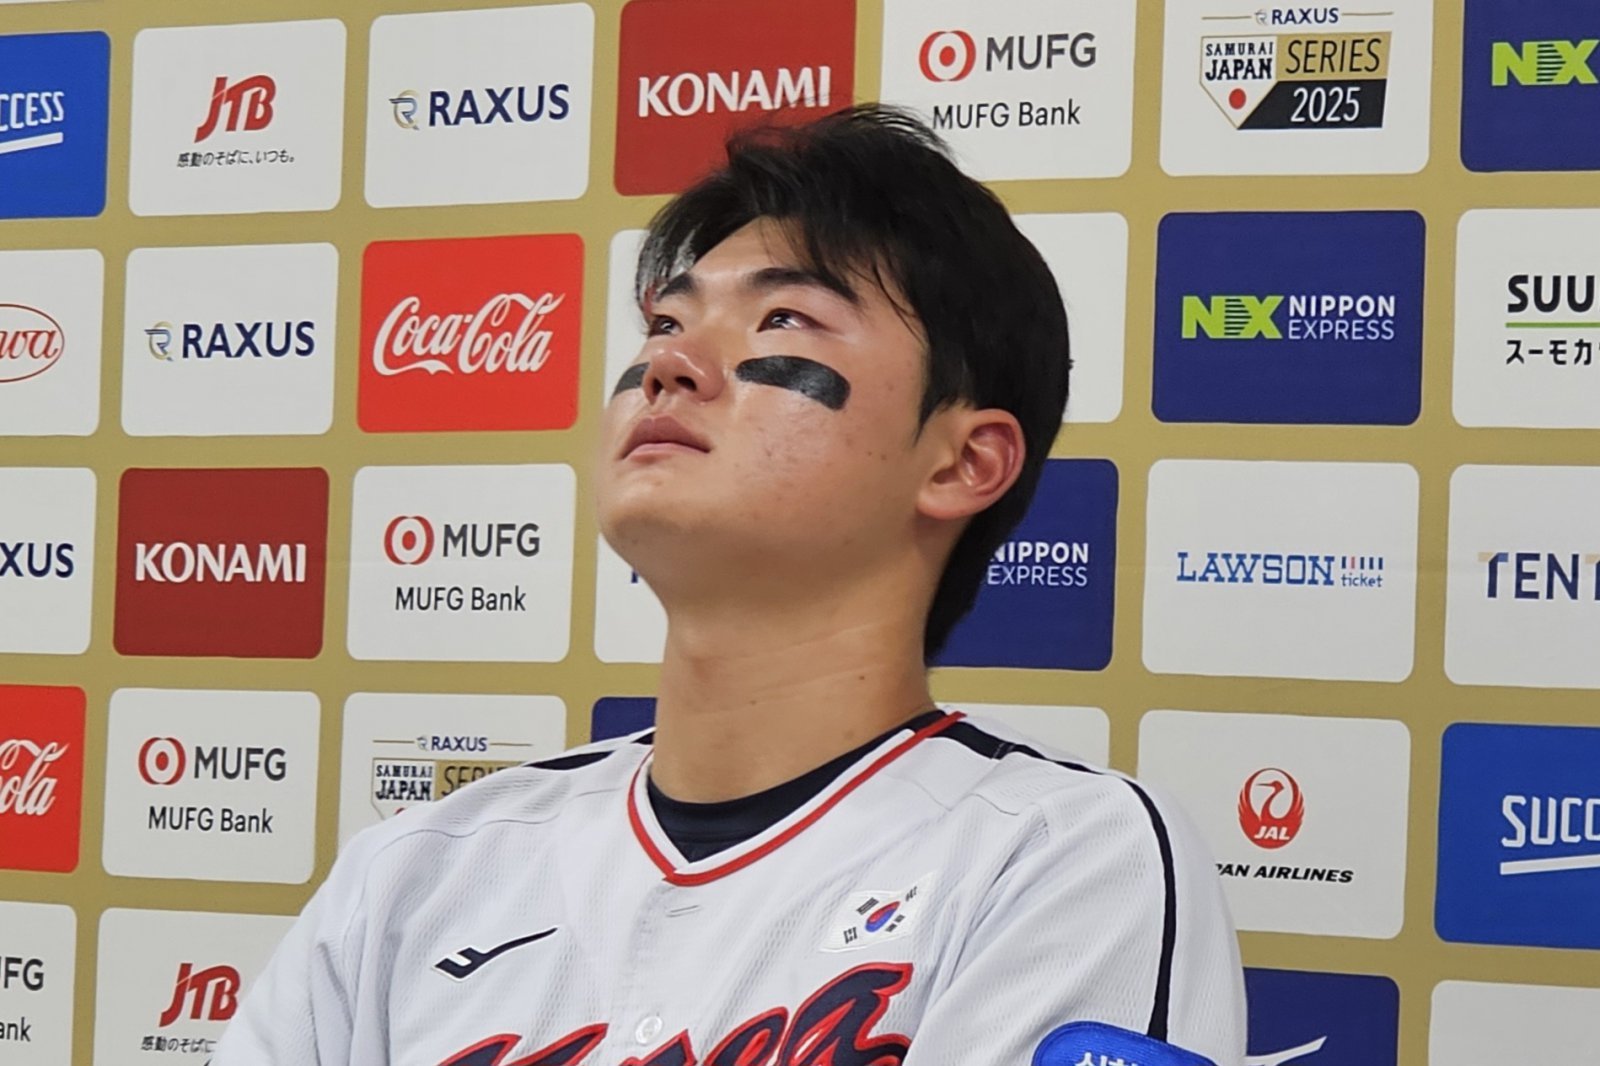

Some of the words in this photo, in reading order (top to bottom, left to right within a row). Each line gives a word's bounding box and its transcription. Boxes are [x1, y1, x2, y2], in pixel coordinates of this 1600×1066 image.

[1271, 8, 1340, 26] RAXUS
[985, 32, 1097, 72] MUFG
[1205, 41, 1274, 57] SAMURAI
[1285, 37, 1382, 75] SERIES
[1205, 57, 1273, 82] JAPAN
[428, 83, 571, 128] RAXUS
[637, 65, 832, 118] KONAMI
[1290, 86, 1361, 124] 2025
[193, 74, 277, 144] JTB
[932, 102, 1010, 131] MUFG
[1018, 98, 1081, 127] Bank
[1288, 295, 1396, 318] NIPPON
[182, 320, 316, 359] RAXUS
[372, 292, 566, 377] Coca-Cola
[1288, 320, 1395, 341] EXPRESS
[443, 522, 541, 558] MUFG
[0, 541, 75, 579] XUS
[135, 541, 307, 583] KONAMI
[987, 564, 1088, 587] EXPRESS
[1176, 551, 1336, 587] LAWSON
[1340, 573, 1384, 588] ticket
[395, 585, 464, 613] MUFG
[471, 587, 526, 613] Bank
[430, 735, 489, 753] RAXUS
[194, 746, 287, 782] MUFG
[375, 764, 434, 779] SAMURAI
[374, 780, 433, 801] JAPAN
[148, 806, 213, 832] MUFG
[220, 807, 273, 833] Bank
[1253, 825, 1292, 841] JAL
[1501, 794, 1600, 848] SUCC
[1252, 864, 1355, 884] AIRLINES
[158, 962, 242, 1028] JTB
